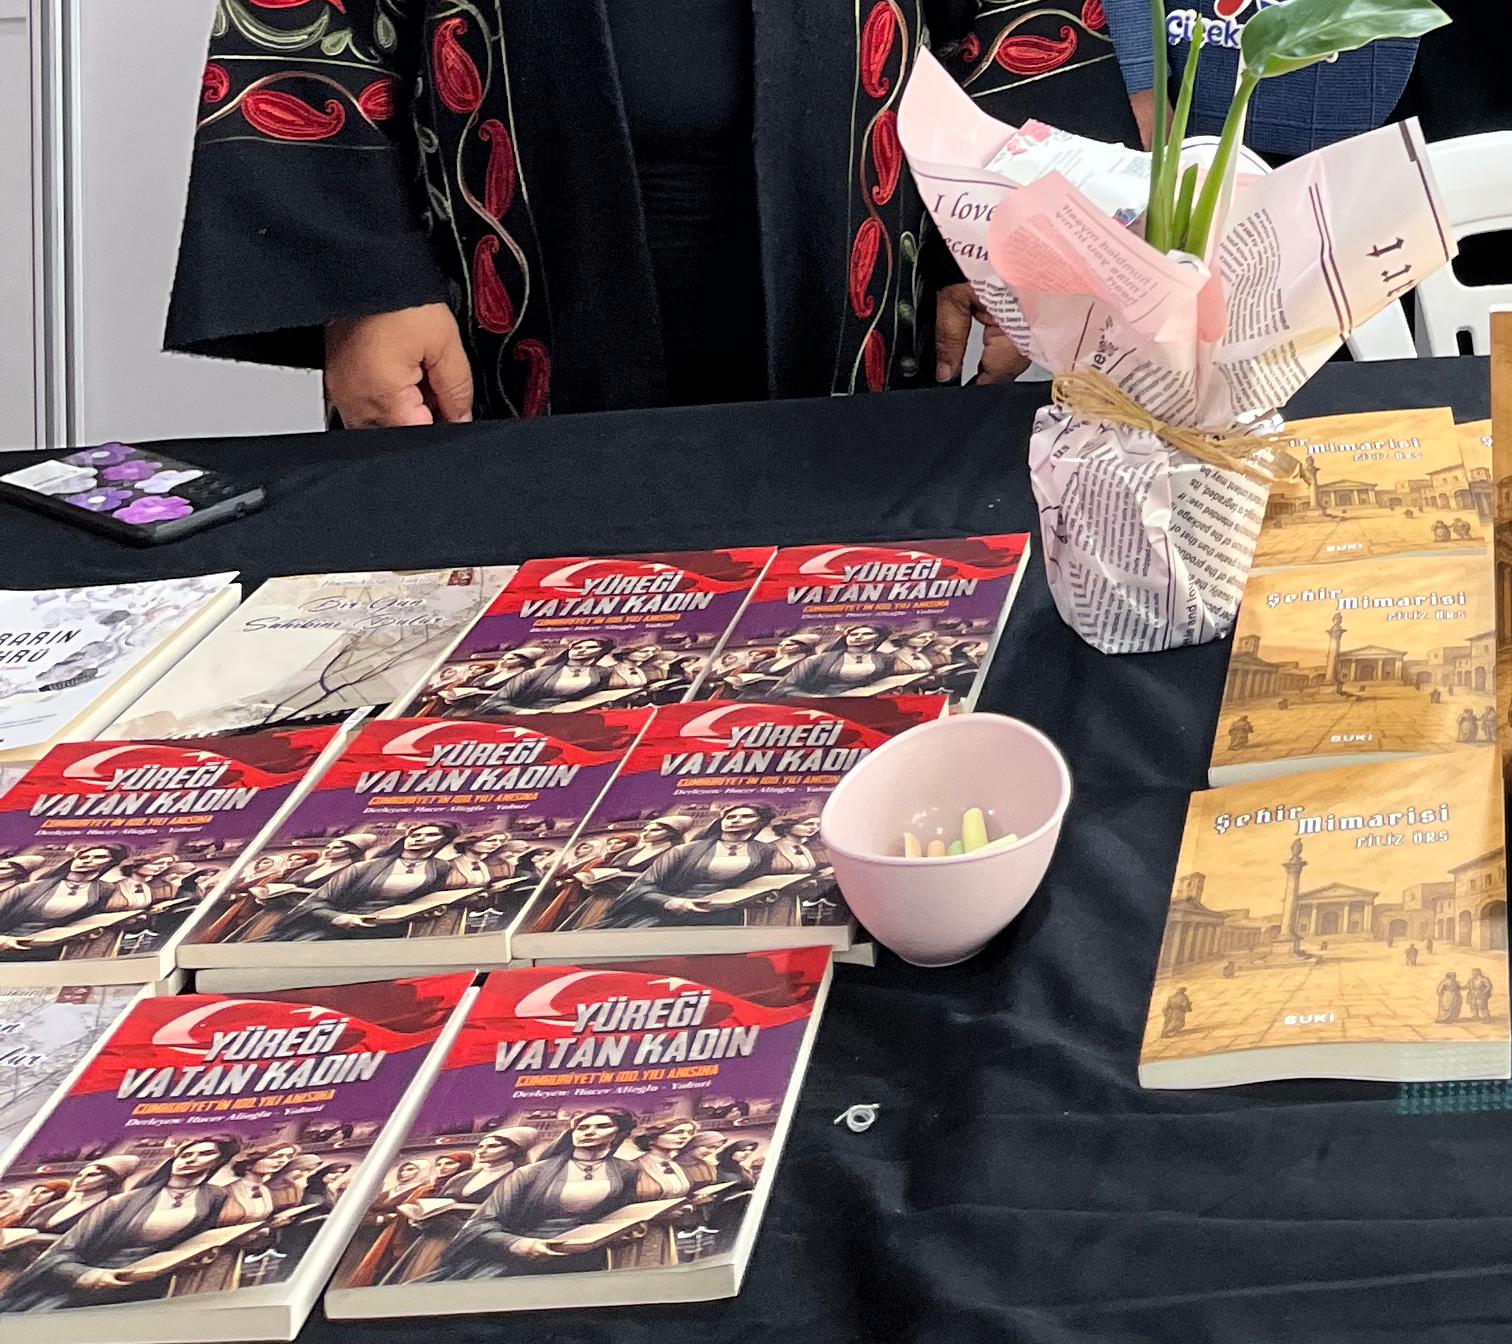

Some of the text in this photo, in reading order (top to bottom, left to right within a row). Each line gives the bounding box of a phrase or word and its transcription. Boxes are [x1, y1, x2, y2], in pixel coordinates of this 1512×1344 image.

[1305, 436, 1422, 457] Mimarisi
[580, 569, 684, 596] YÜREĞİ
[841, 559, 943, 583] YÜREĞİ
[519, 592, 715, 618] VATAN KADIN
[786, 578, 978, 605] VATAN KADIN
[1265, 586, 1343, 611] Şehir
[1336, 591, 1468, 614] Mimarisi
[726, 720, 845, 749] YÜREĞİ
[428, 737, 546, 768] YÜREĞİ
[660, 751, 773, 776] VATAN
[108, 760, 231, 791] YÜREĞİ
[354, 763, 581, 794] VATAN KADIN
[30, 787, 259, 817] VATAN KADIN
[1214, 803, 1450, 835] Şehir Mimarisi
[1412, 830, 1450, 844] ÖRS
[572, 989, 713, 1033] YÜREĞİ
[203, 1018, 349, 1062] YÜREĞİ
[494, 1024, 761, 1073] VATAN KADIN
[115, 1050, 387, 1101] VATAN KADIN
